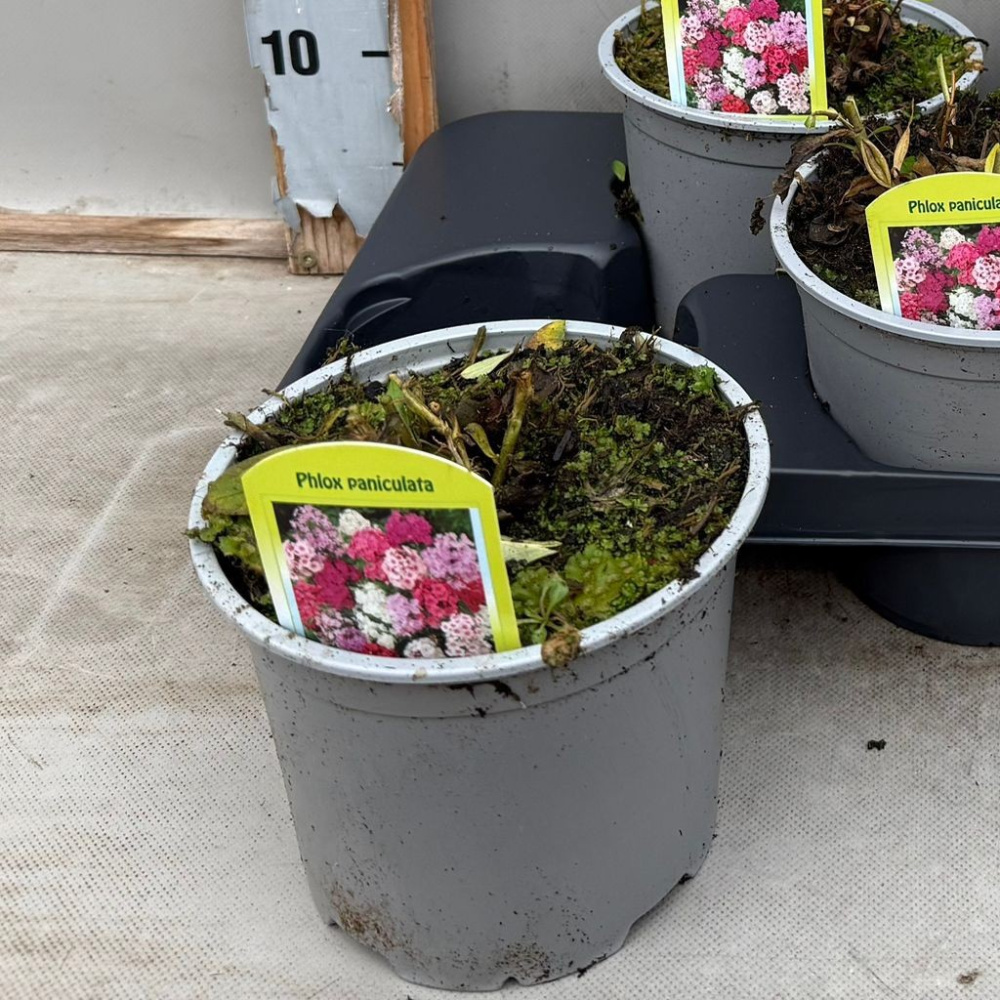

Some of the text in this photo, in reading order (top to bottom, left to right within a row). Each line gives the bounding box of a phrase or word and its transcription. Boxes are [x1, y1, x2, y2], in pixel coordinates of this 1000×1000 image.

[261, 29, 319, 76] 10
[908, 200, 945, 213] Phlox
[296, 472, 434, 492] Phlox paniculata
